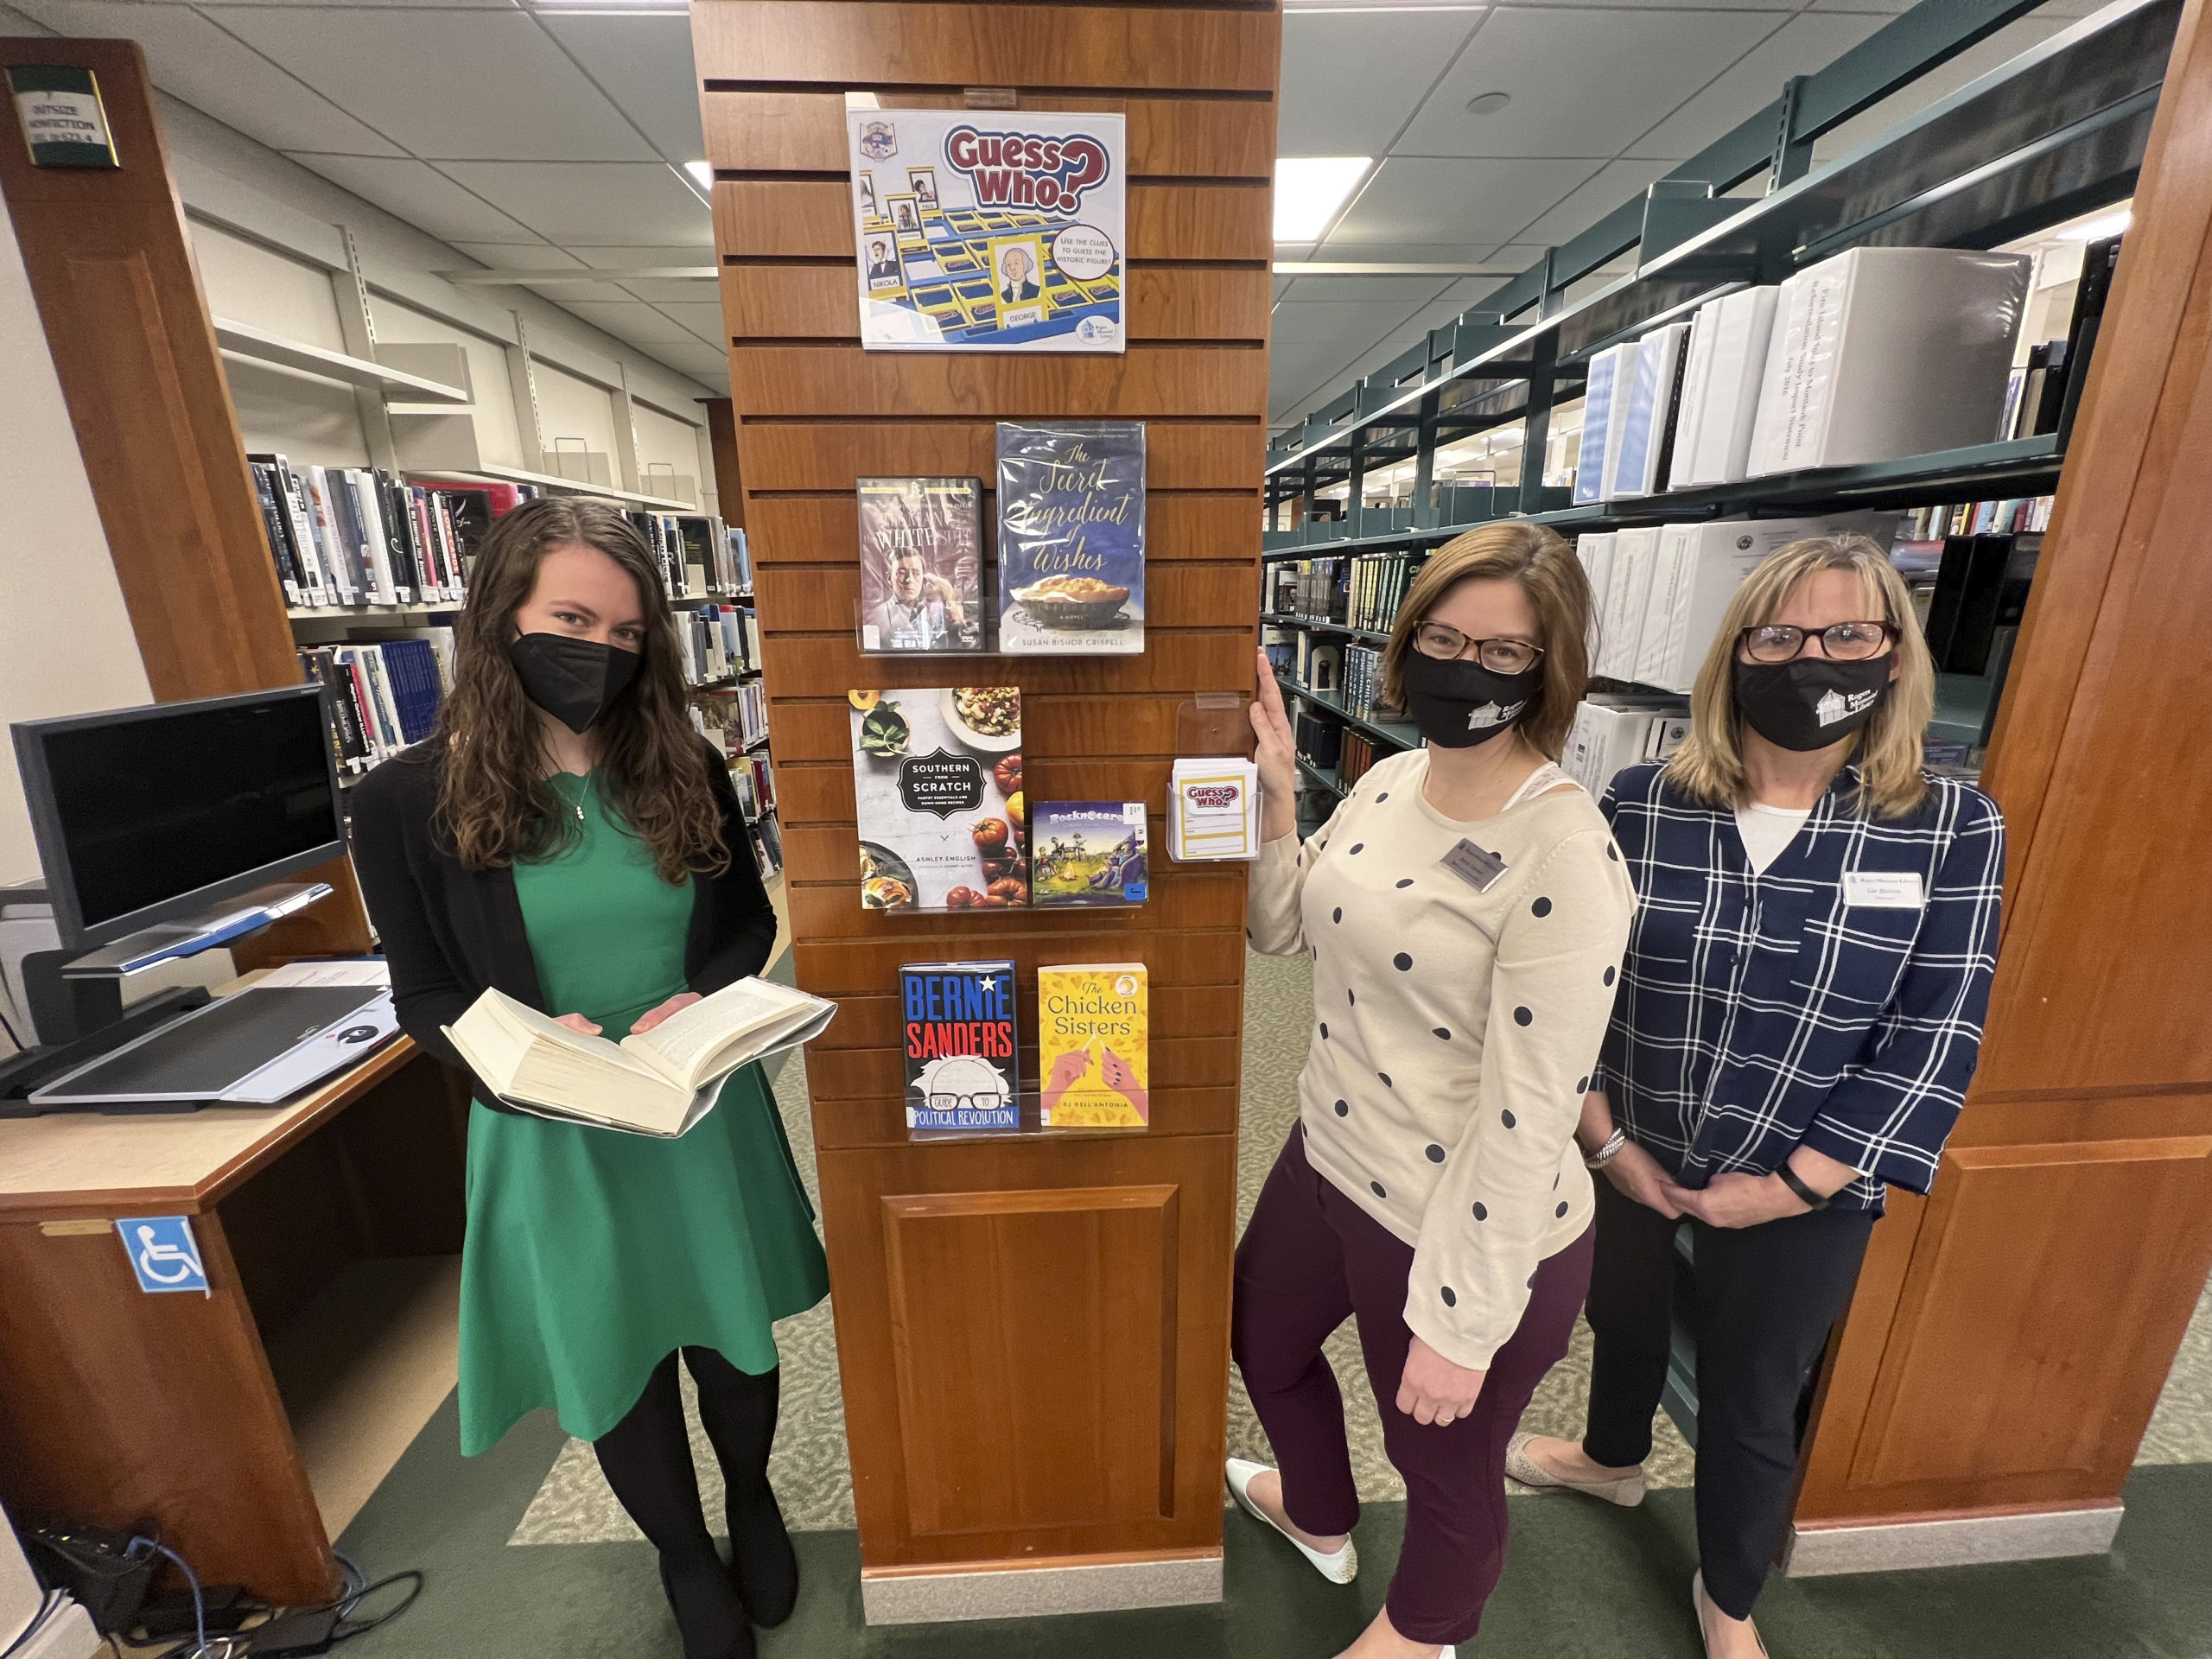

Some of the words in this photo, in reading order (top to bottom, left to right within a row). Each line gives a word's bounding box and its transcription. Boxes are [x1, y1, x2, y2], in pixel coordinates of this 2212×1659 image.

[950, 131, 1063, 171] Guess
[873, 278, 898, 288] NIKOLA
[1009, 311, 1037, 322] GEORGE
[1065, 443, 1090, 464] The
[1039, 459, 1111, 493] Secret
[442, 510, 453, 537] LOVE
[448, 540, 459, 573] CARDS
[875, 528, 935, 550] WHITE
[1033, 536, 1108, 573] Wishes
[1086, 638, 1124, 646] CRISPELL
[912, 764, 969, 772] SOUTHERN
[912, 781, 971, 792] SCRATCH
[1188, 788, 1224, 798] Guess
[1049, 810, 1123, 823] Rocknocero
[1083, 982, 1103, 995] The
[906, 975, 1012, 1021] BERNIE
[1048, 995, 1137, 1015] Chicken
[1054, 1017, 1131, 1035] Sisters
[907, 1022, 1013, 1058] SANDERS
[935, 1098, 952, 1107] GUIDE
[982, 1097, 989, 1106] TO
[914, 1110, 956, 1126] POLITICAL
[958, 1110, 1014, 1125] REVOLUTION
